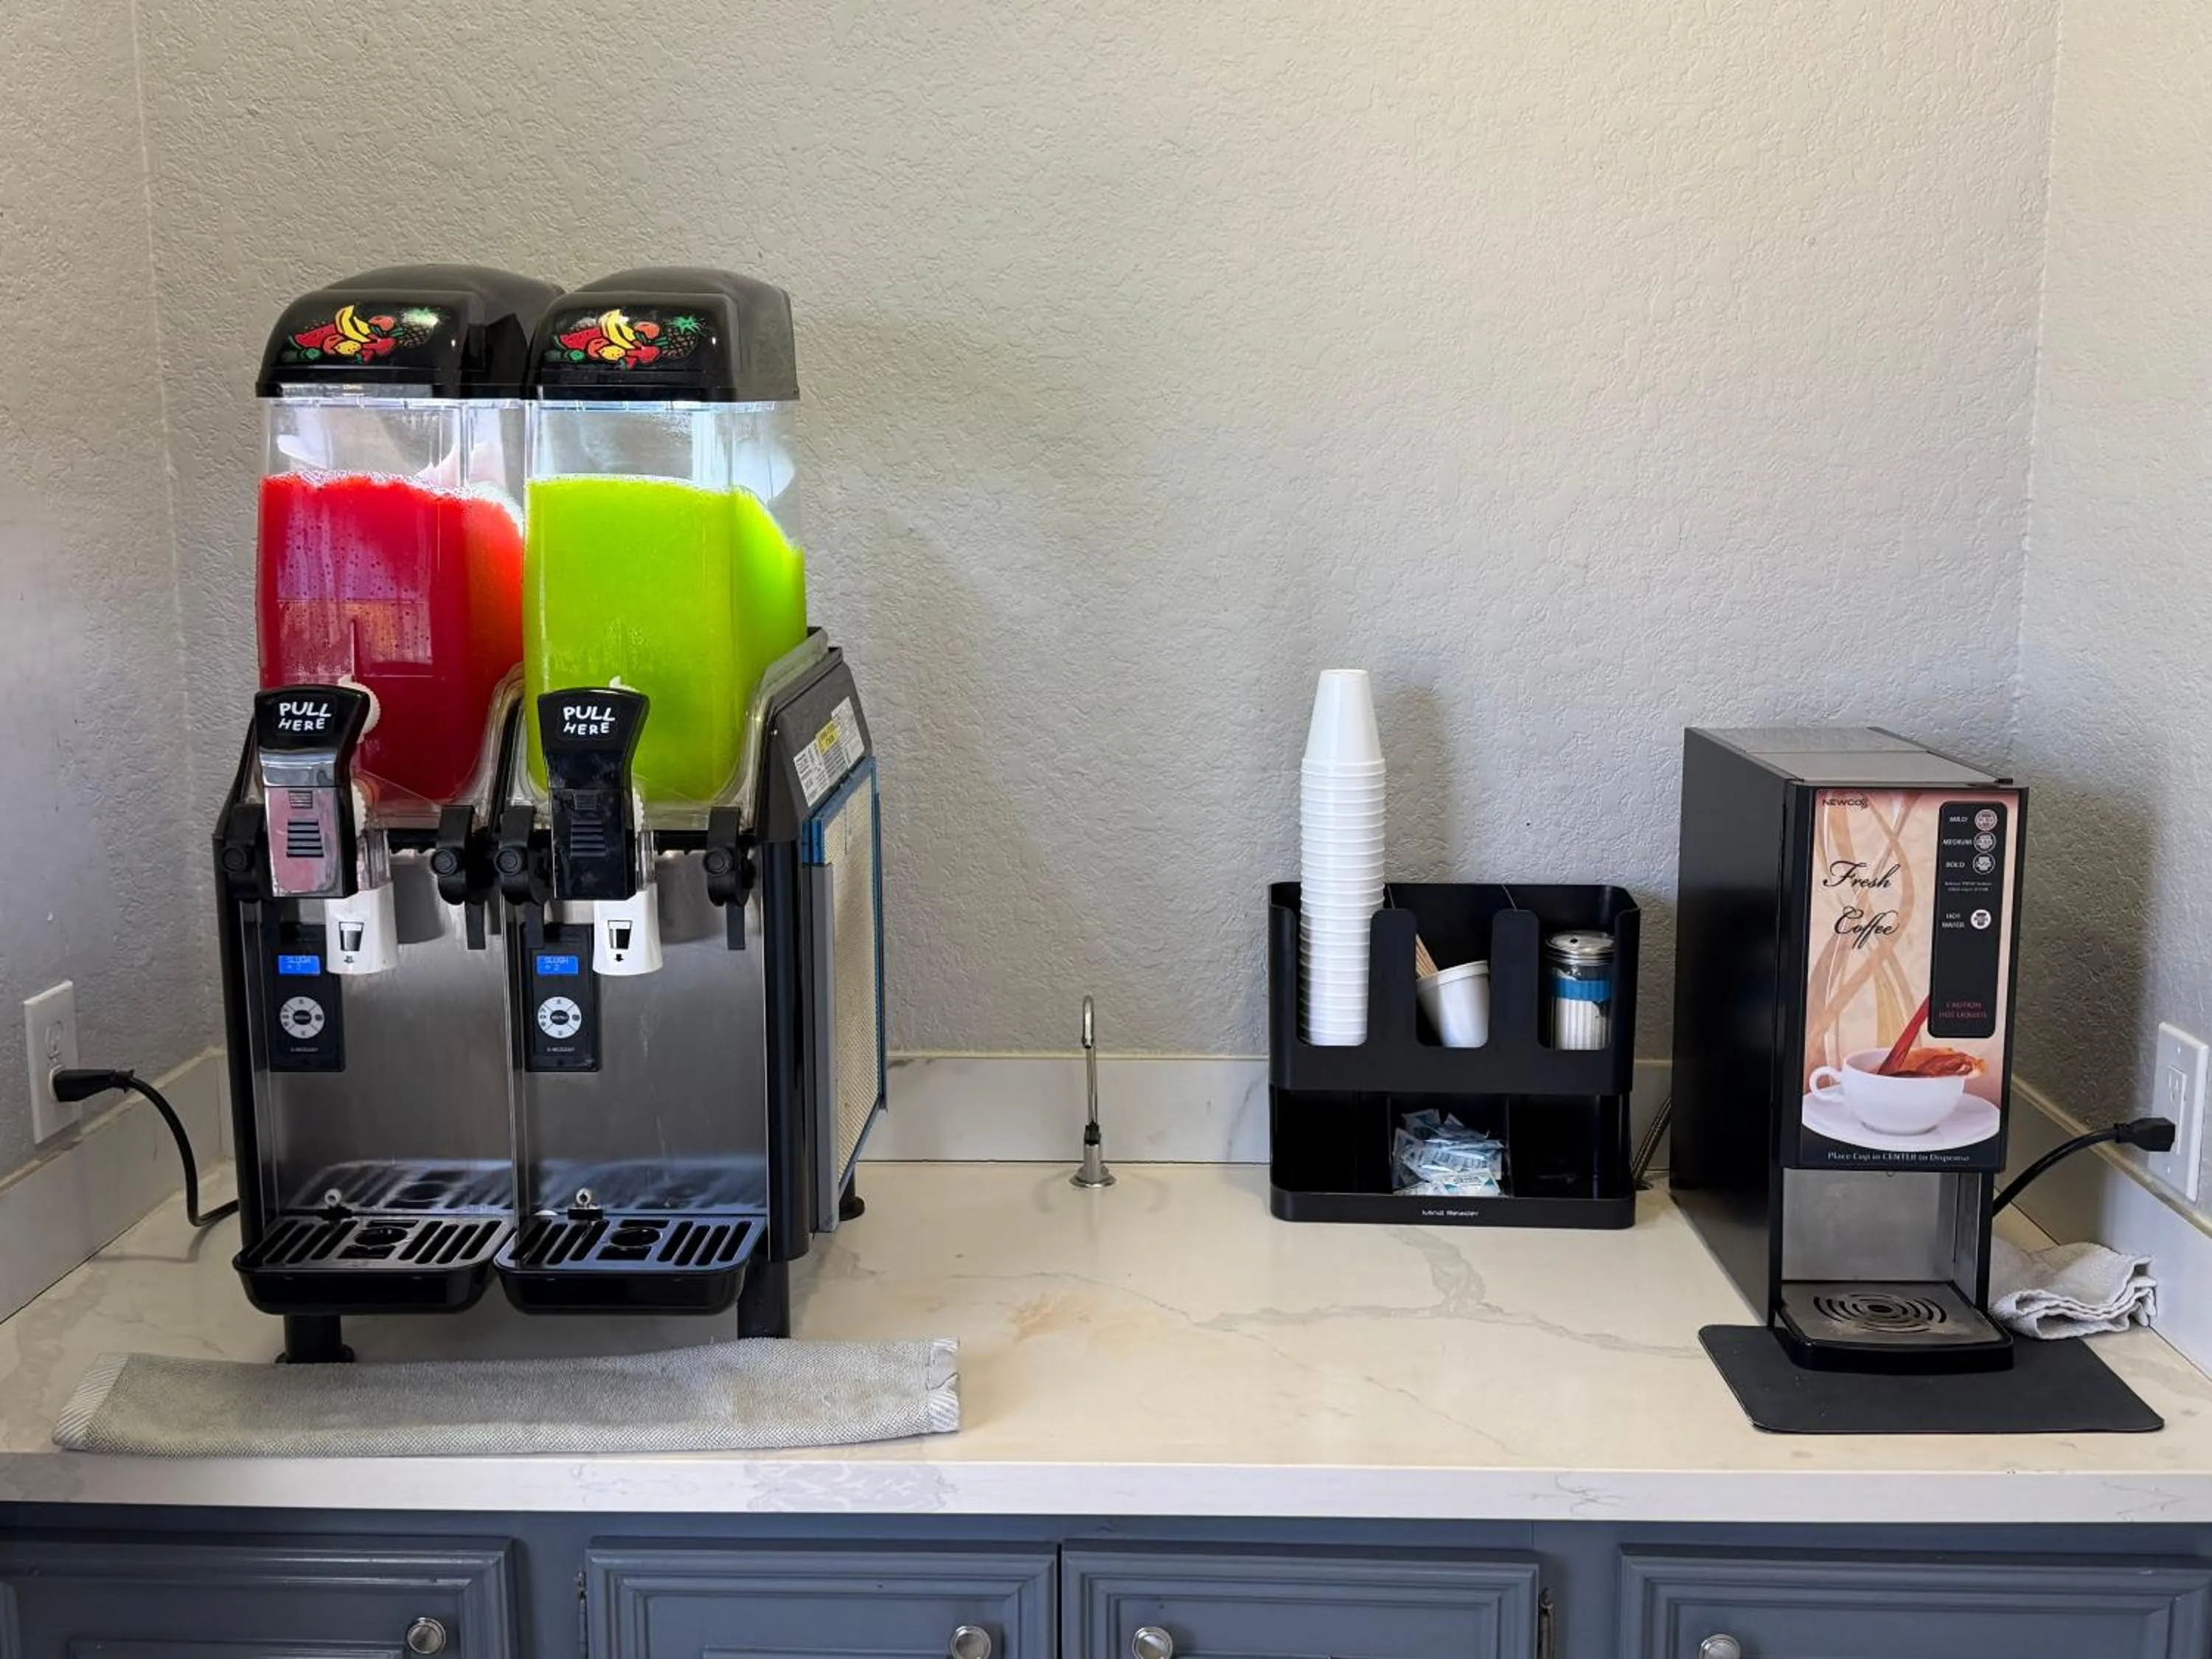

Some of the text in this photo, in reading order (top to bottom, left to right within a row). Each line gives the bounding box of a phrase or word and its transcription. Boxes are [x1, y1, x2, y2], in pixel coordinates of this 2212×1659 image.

[279, 701, 332, 717] PULL
[563, 705, 616, 722] PULL
[278, 717, 325, 731] HERE
[563, 721, 610, 735] HERE
[1822, 860, 1901, 889] Fresh
[1834, 905, 1901, 950] Coffee
